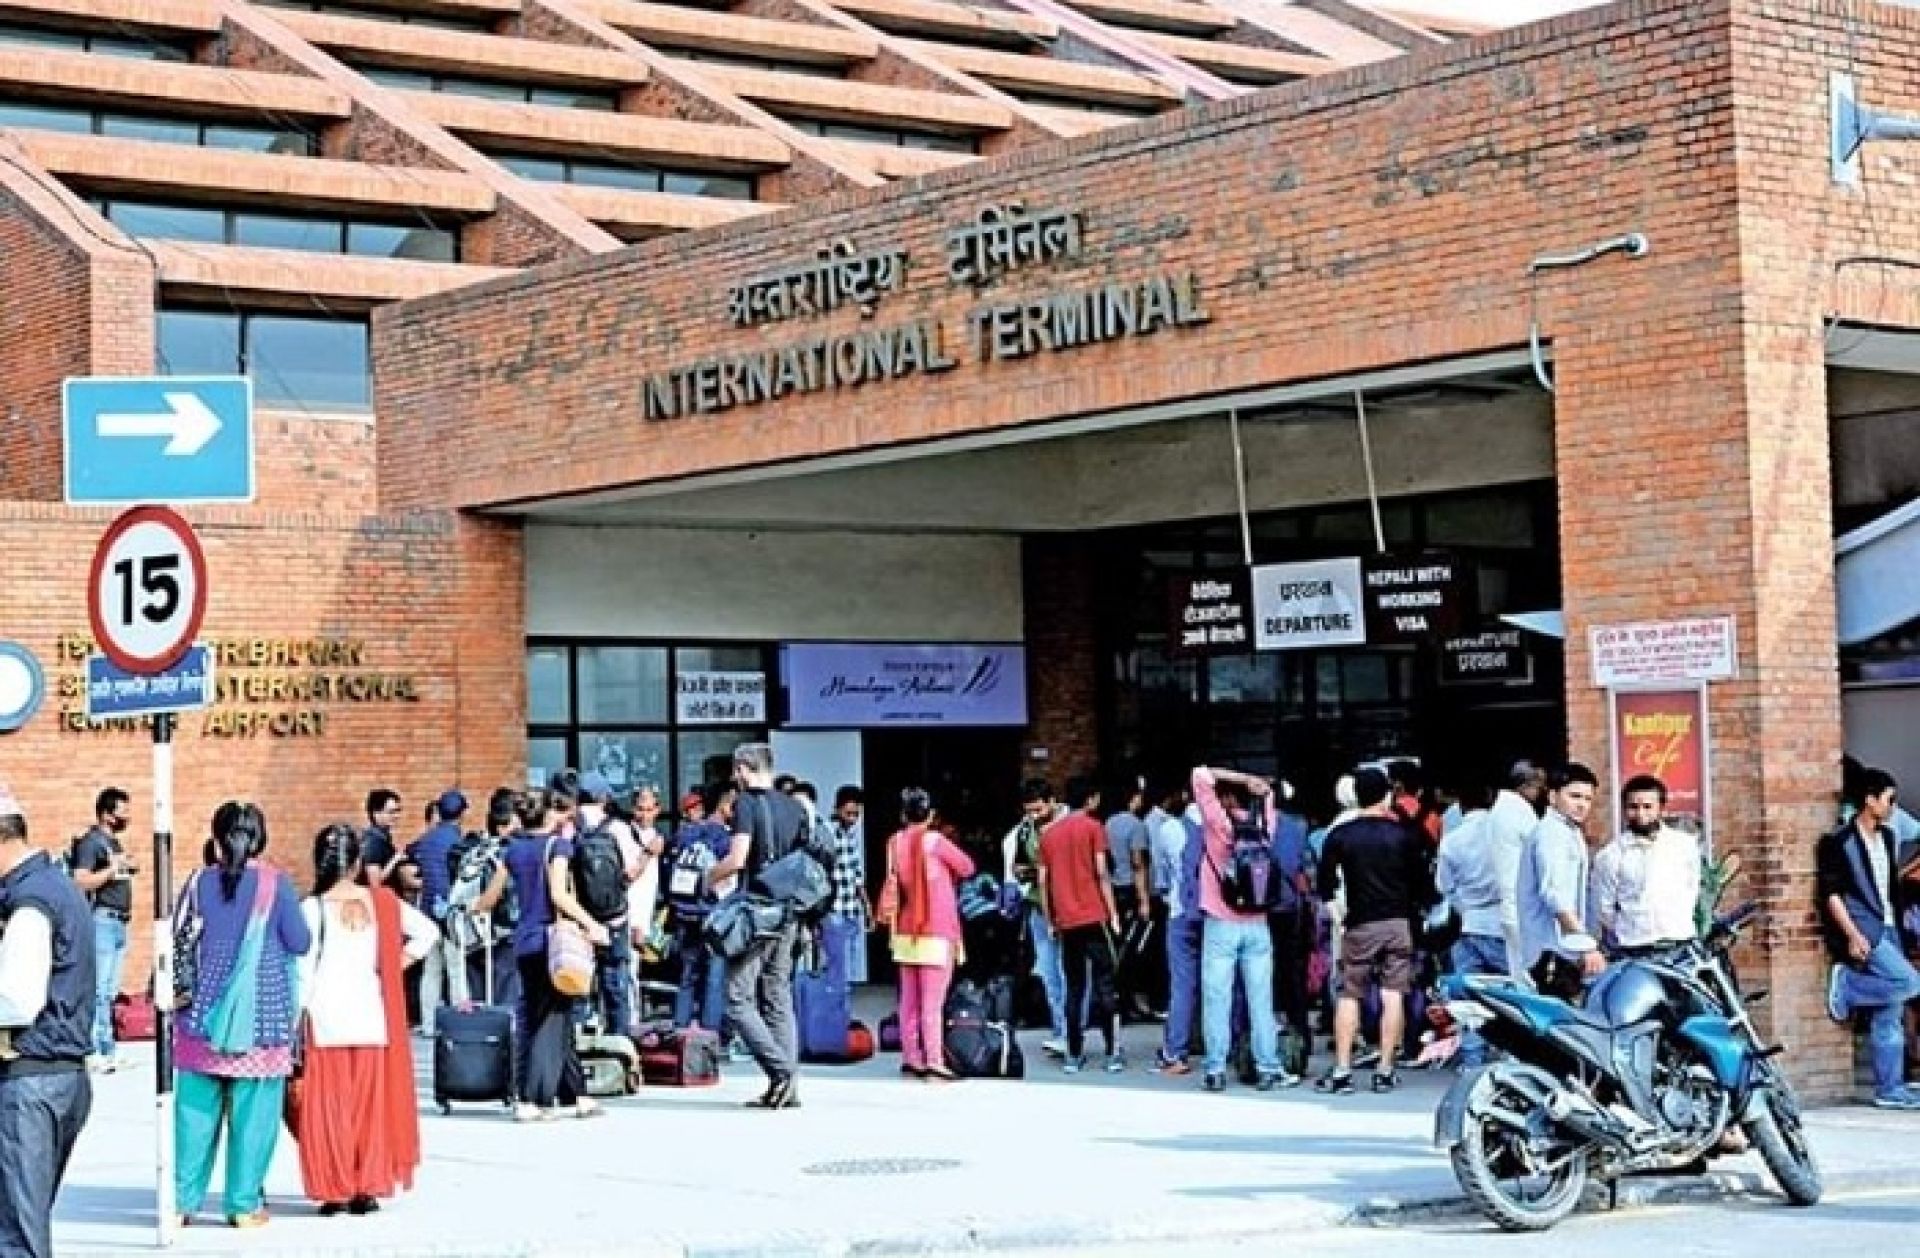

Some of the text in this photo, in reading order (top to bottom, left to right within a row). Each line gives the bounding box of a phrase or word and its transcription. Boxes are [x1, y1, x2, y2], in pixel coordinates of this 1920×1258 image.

[641, 273, 1212, 421] INTERNATIONAL TERMINAL
[1416, 565, 1452, 584] WITH
[114, 553, 180, 626] 15
[1377, 590, 1443, 609] WORKING
[1264, 612, 1353, 637] DEPARTURE
[1394, 614, 1429, 632] VISA
[215, 672, 419, 703] NTERNATIONAL
[203, 708, 327, 739] AIRPORT
